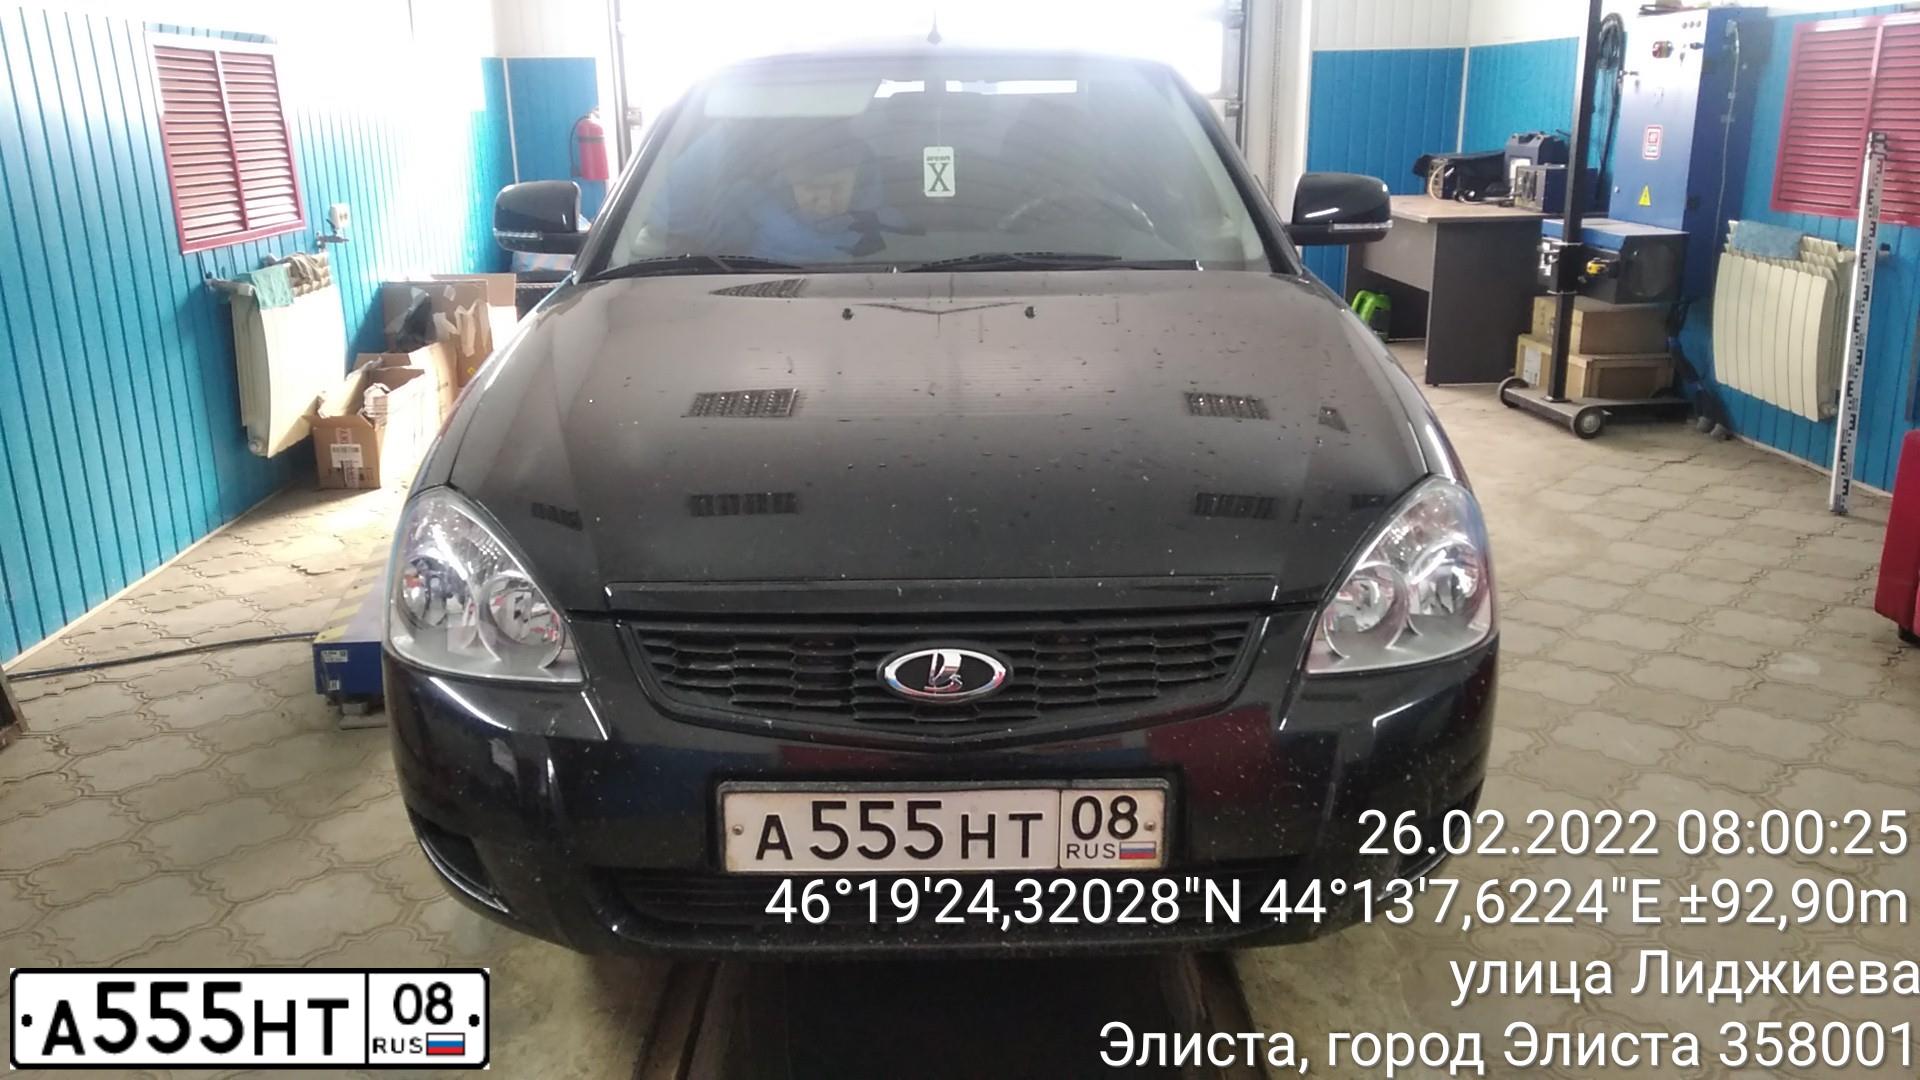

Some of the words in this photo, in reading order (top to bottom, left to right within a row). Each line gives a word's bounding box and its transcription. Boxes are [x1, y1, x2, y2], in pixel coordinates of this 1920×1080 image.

[755, 800, 1044, 861] А555НТ
[1071, 795, 1140, 841] 08
[1066, 843, 1117, 859] RUS
